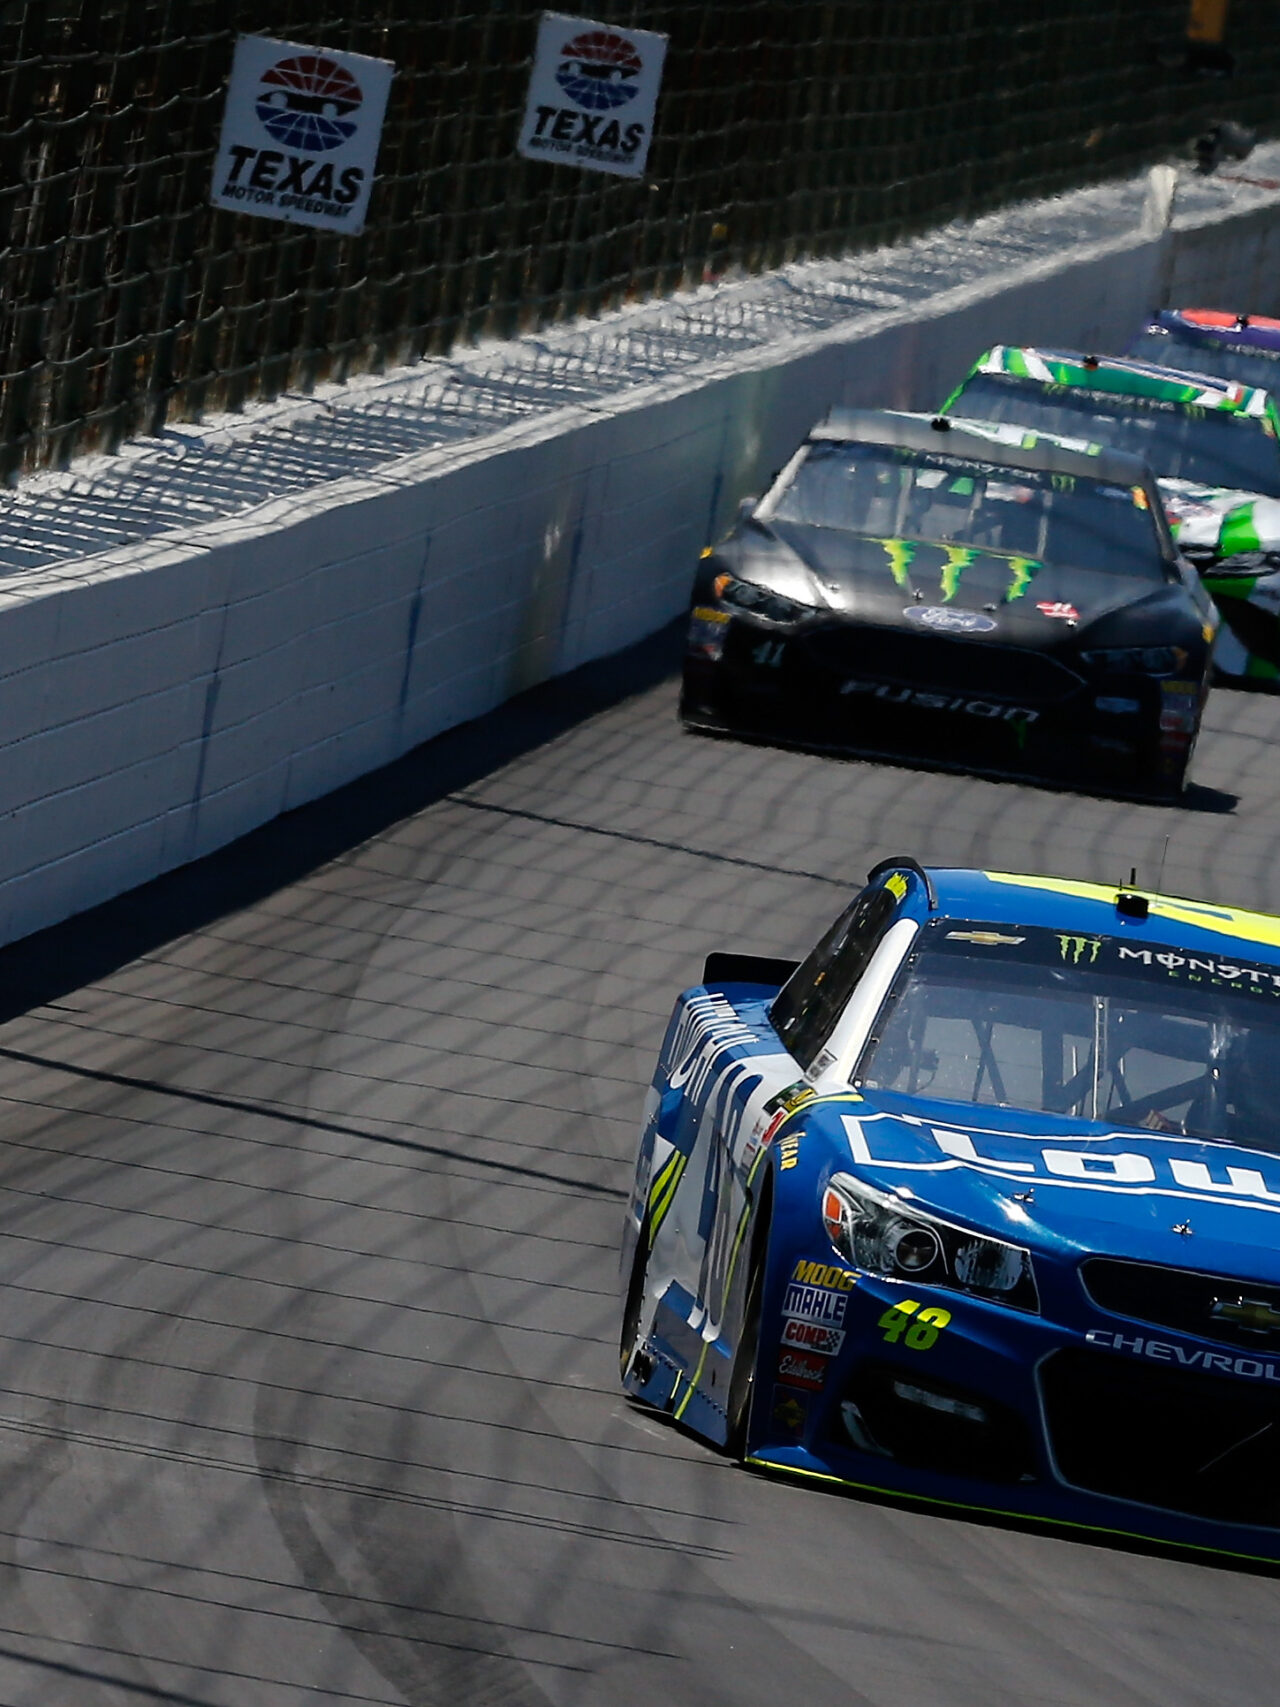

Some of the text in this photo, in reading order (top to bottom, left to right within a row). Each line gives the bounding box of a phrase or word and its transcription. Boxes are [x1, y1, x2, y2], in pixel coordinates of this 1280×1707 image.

[535, 106, 645, 152] TEXAS
[229, 145, 364, 203] TEXAS
[222, 184, 353, 217] MOTOR SPEEDWAY
[791, 1259, 862, 1292] MOOG
[783, 1285, 848, 1322] MAHLE
[785, 1322, 827, 1344] COMP
[877, 1299, 952, 1351] 48
